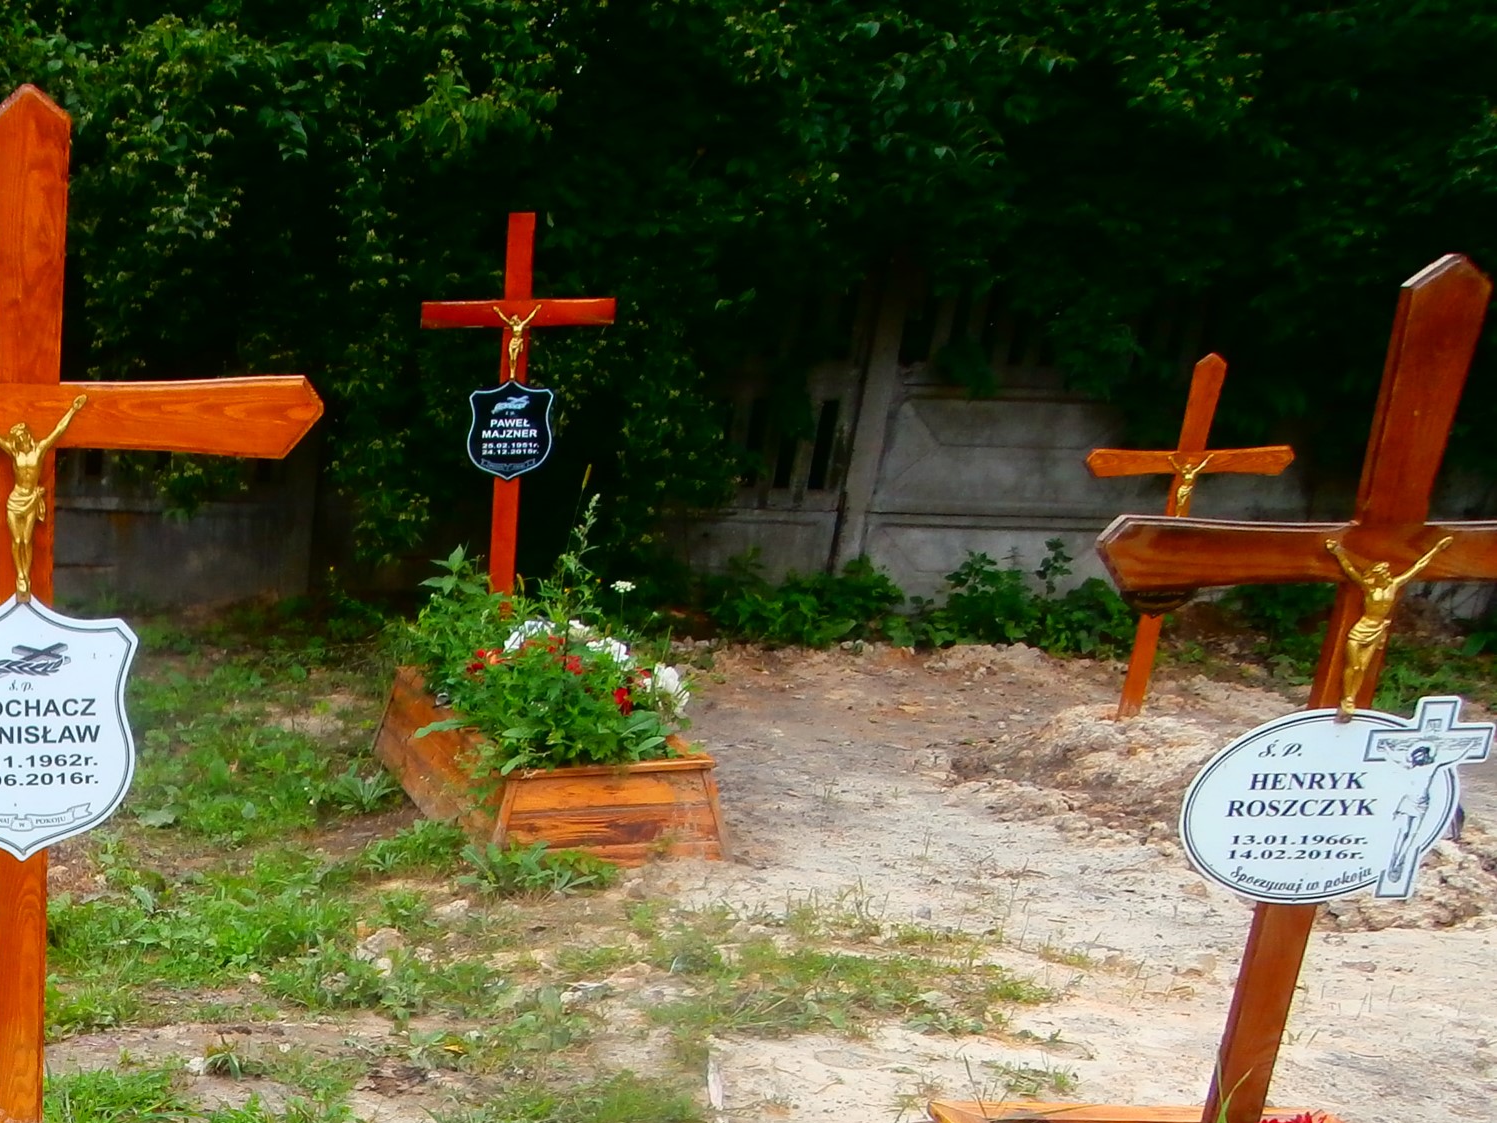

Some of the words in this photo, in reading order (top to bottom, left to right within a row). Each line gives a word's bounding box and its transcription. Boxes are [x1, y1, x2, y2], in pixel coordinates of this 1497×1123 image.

[490, 418, 530, 428] PAWEŁ
[482, 429, 538, 439] MAJZNER
[1248, 771, 1368, 791] HENRYK
[1225, 798, 1378, 818] ROSZCZYK
[35, 816, 66, 824] POKOJU
[1230, 834, 1369, 846] 13.01.1966r.
[1227, 848, 1365, 860] 14.02.2016r.
[1229, 865, 1304, 893] Spoczywaj
[1306, 880, 1320, 891] w
[1323, 865, 1373, 892] pokoju
